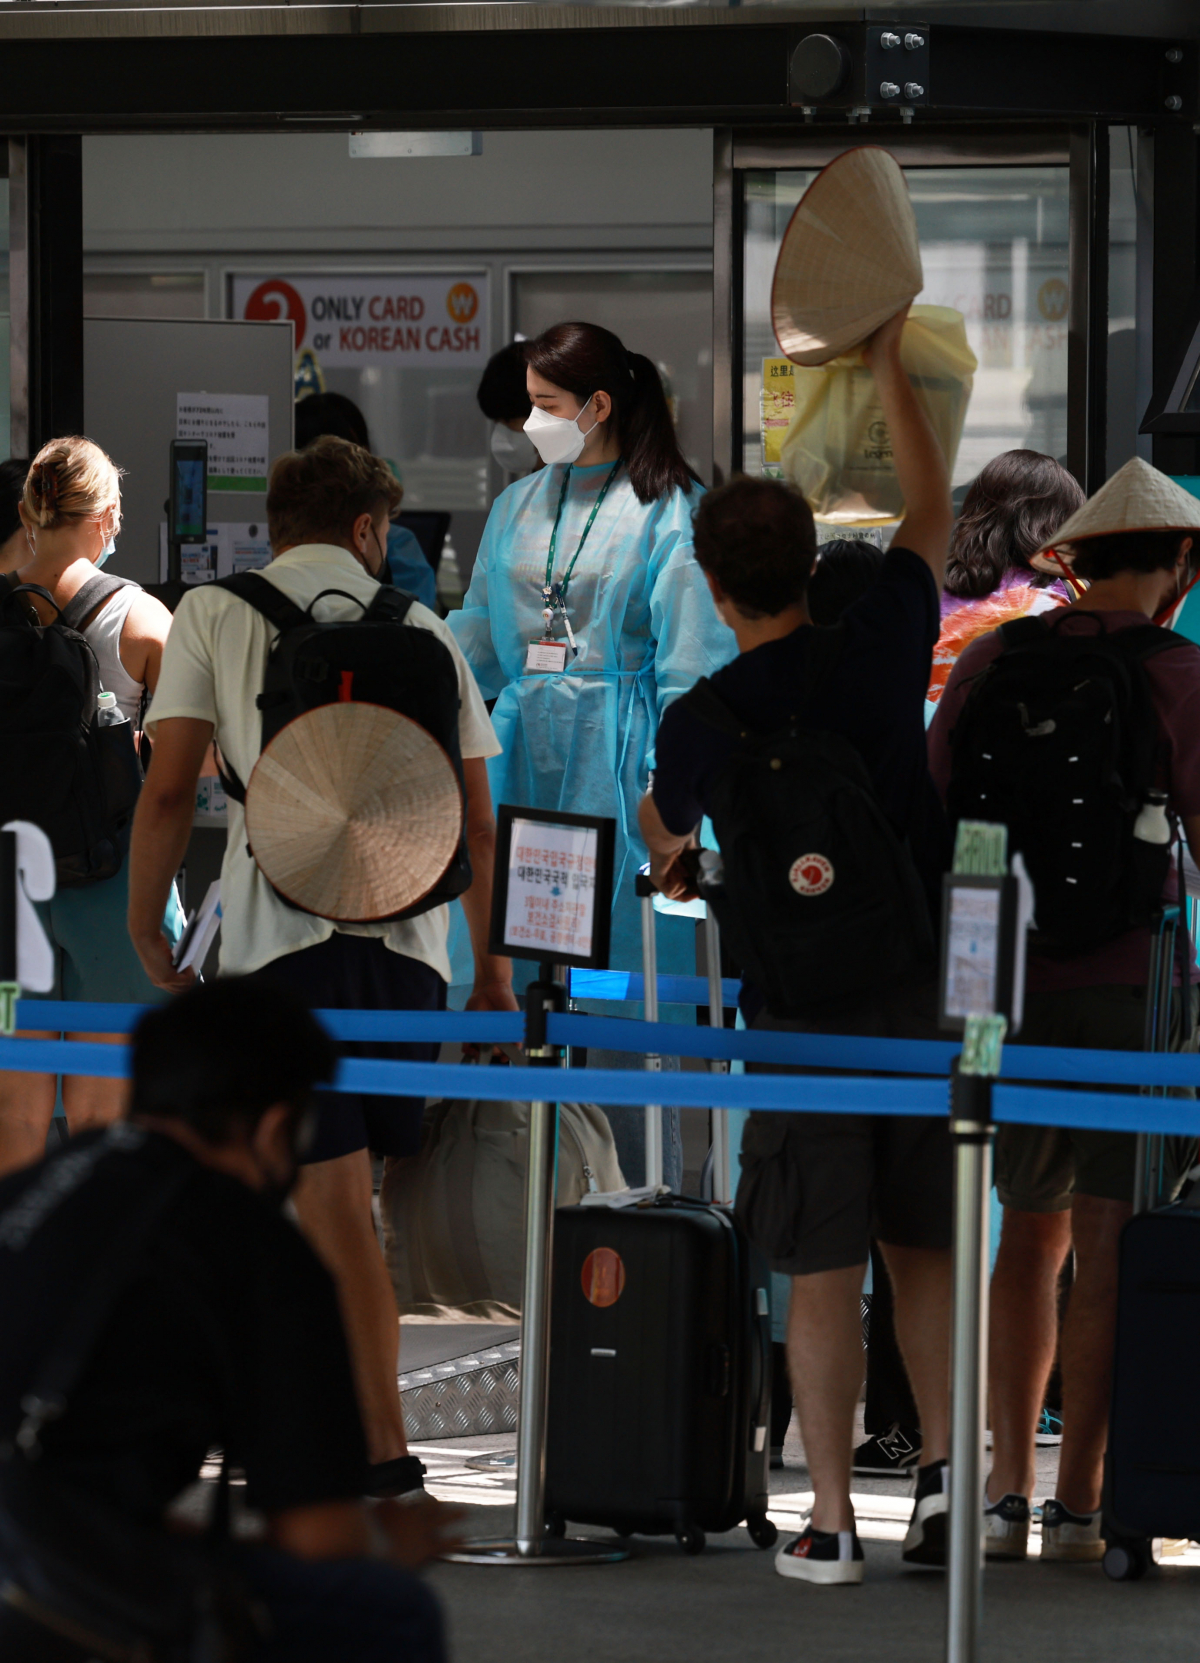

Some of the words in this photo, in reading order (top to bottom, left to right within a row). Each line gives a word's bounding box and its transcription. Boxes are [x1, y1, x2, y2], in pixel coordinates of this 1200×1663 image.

[311, 296, 364, 321] ONLY
[368, 296, 424, 321] CARD
[313, 333, 331, 351] or
[339, 326, 420, 351] KOREAN
[425, 326, 480, 351] CASH
